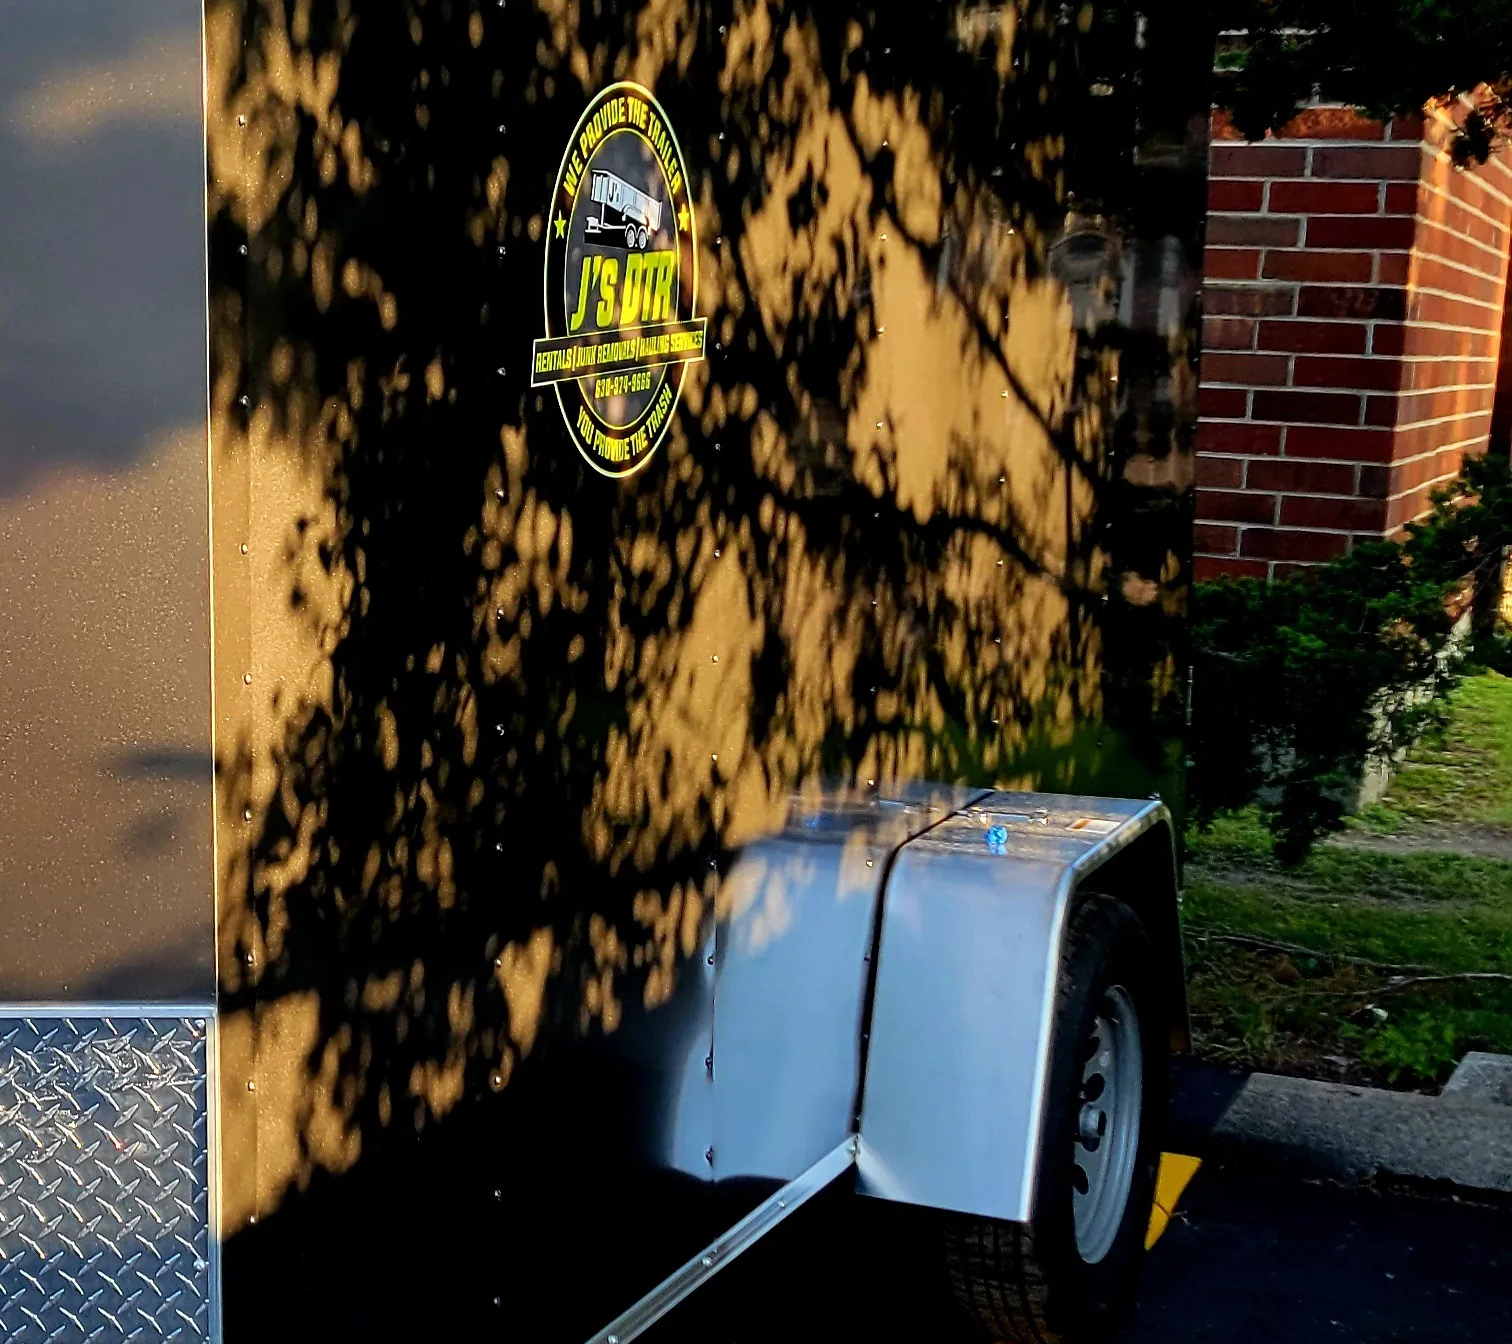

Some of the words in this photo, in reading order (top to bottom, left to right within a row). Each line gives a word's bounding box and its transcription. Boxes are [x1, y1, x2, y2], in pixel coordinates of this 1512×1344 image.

[563, 149, 583, 196] WE
[579, 97, 626, 159] PROVIDE
[627, 96, 649, 129] THE
[648, 111, 682, 194] TRAILER
[570, 255, 619, 331] J'S
[619, 250, 675, 326] DTR
[535, 348, 572, 373] RENTALS
[576, 345, 597, 367] JUNK
[597, 338, 636, 364] REMOVALS
[577, 406, 594, 444] YOU
[593, 429, 630, 462] PROVIDE
[630, 425, 648, 456] THE
[646, 383, 672, 438] TRASH
